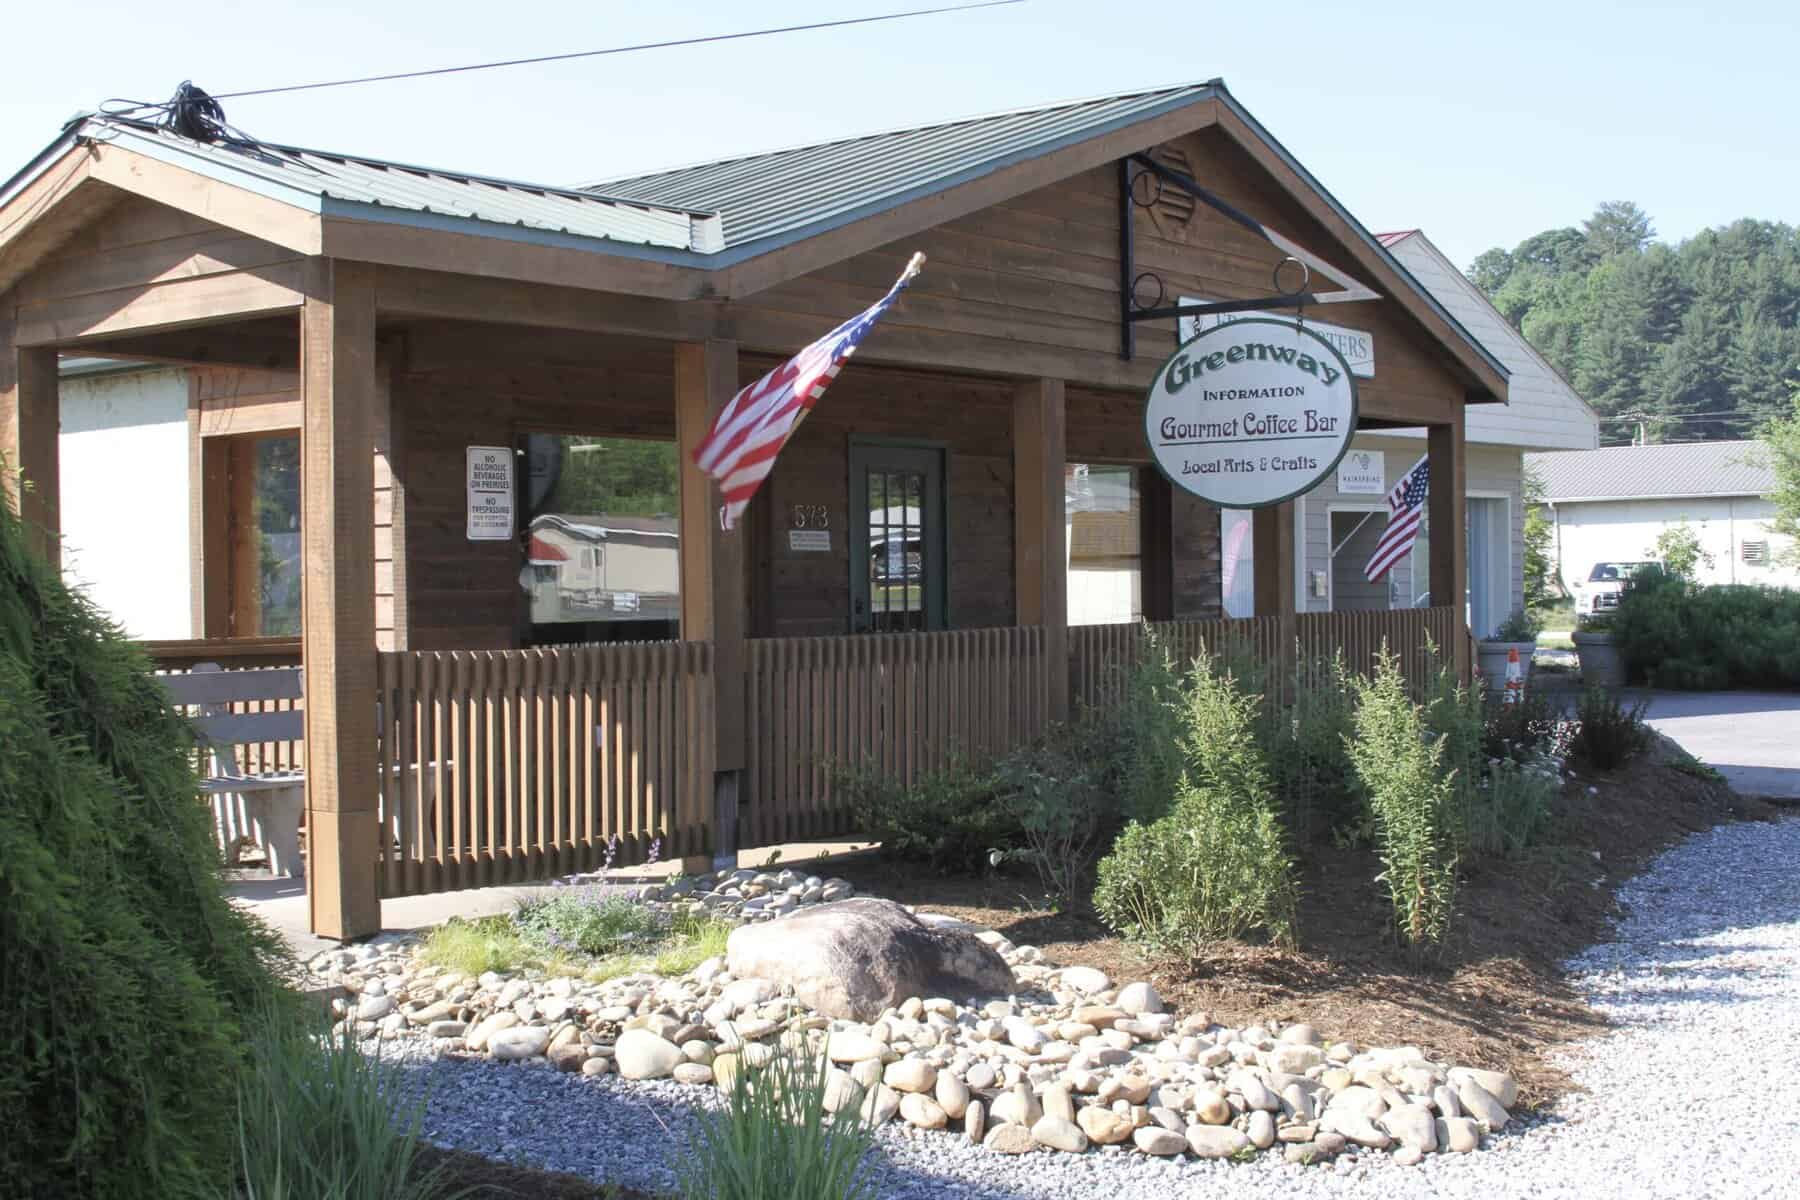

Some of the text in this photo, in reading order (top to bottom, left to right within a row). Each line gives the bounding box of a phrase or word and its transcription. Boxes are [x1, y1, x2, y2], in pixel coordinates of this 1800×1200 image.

[1165, 343, 1341, 395] Greenway
[1203, 386, 1305, 401] INFORMATION
[1160, 410, 1338, 440] Gourmet Coffee Bar
[484, 455, 496, 463] NO
[1181, 457, 1317, 475] Local Arts & Crafts
[473, 472, 506, 480] BEVERAGES
[471, 480, 509, 489] ON PREMISES
[485, 497, 496, 505] NO
[472, 506, 510, 514] TRESPASSING
[794, 504, 829, 528] 573
